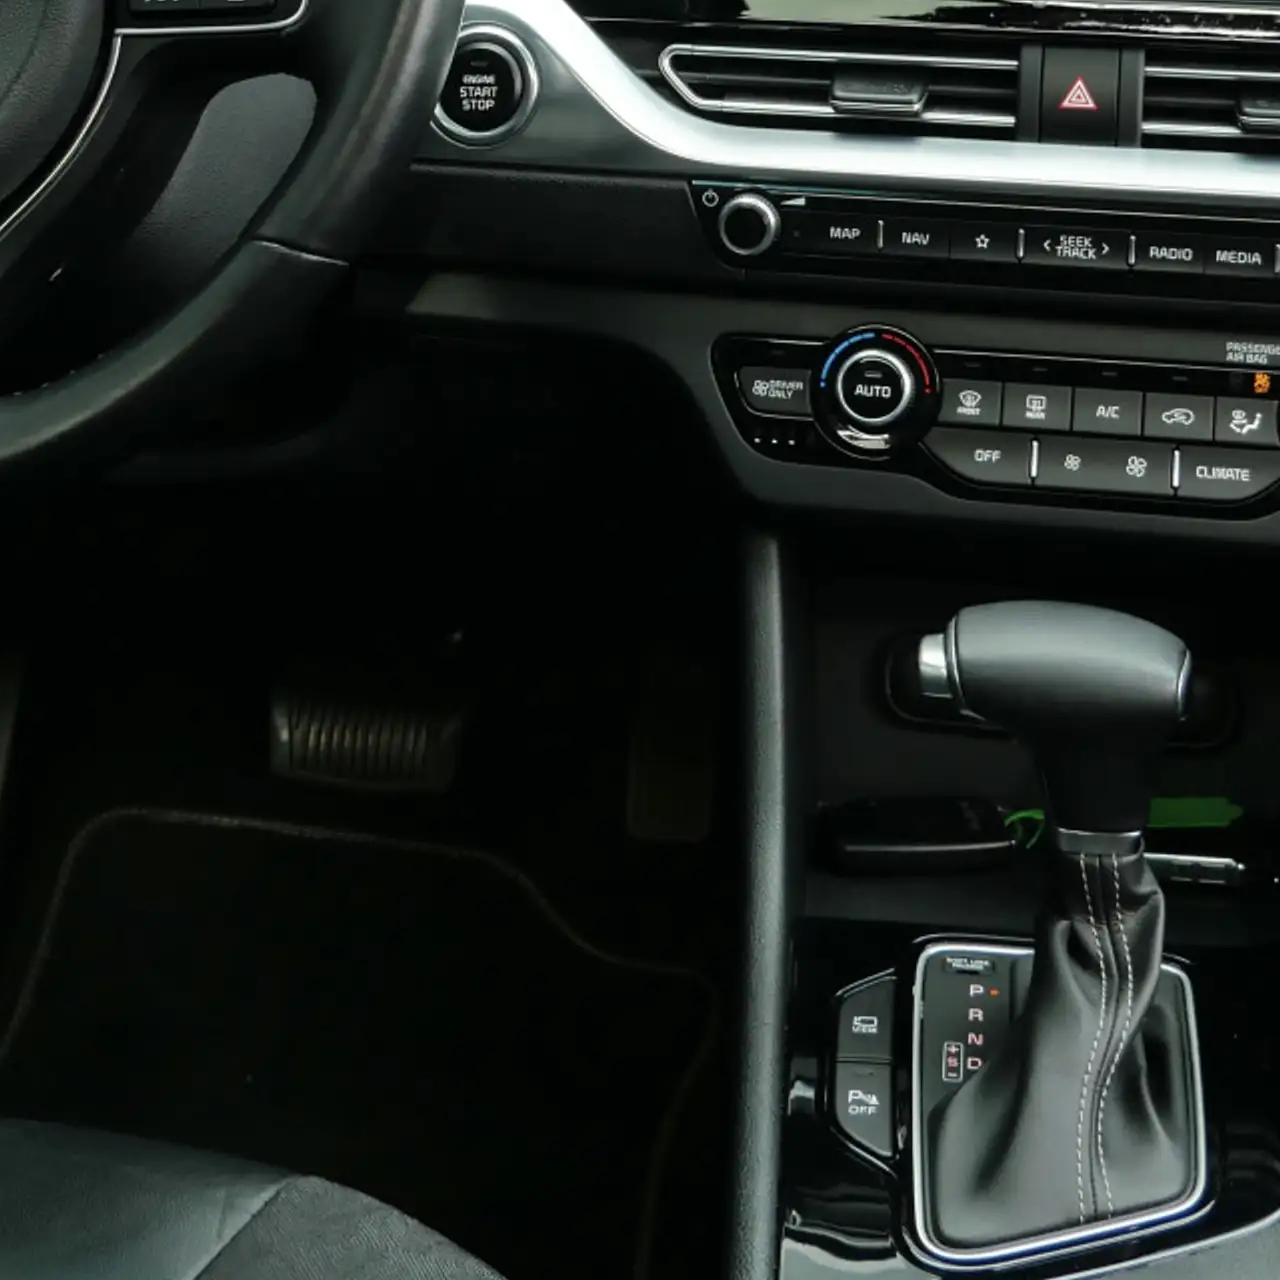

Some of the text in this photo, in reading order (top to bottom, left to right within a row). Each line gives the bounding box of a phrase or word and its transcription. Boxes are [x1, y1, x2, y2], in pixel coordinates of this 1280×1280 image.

[460, 86, 498, 97] START
[462, 98, 495, 111] STOP
[829, 226, 861, 240] MAP
[901, 231, 930, 245] NAV
[1059, 235, 1092, 248] SEEK
[1055, 245, 1097, 259] TRACK
[1149, 246, 1193, 261] RADIO
[1216, 250, 1262, 265] MEDIA
[1226, 352, 1268, 364] AIR BAG
[768, 388, 793, 399] ONLY
[854, 383, 891, 398] AUTO
[1096, 405, 1120, 418] A/C
[974, 449, 1001, 463] OFF
[1195, 465, 1251, 482] CLIMATE
[969, 984, 984, 997] P
[968, 1008, 983, 1021] R
[967, 1033, 983, 1045] N
[967, 1057, 982, 1069] D
[848, 1105, 876, 1115] OFF
